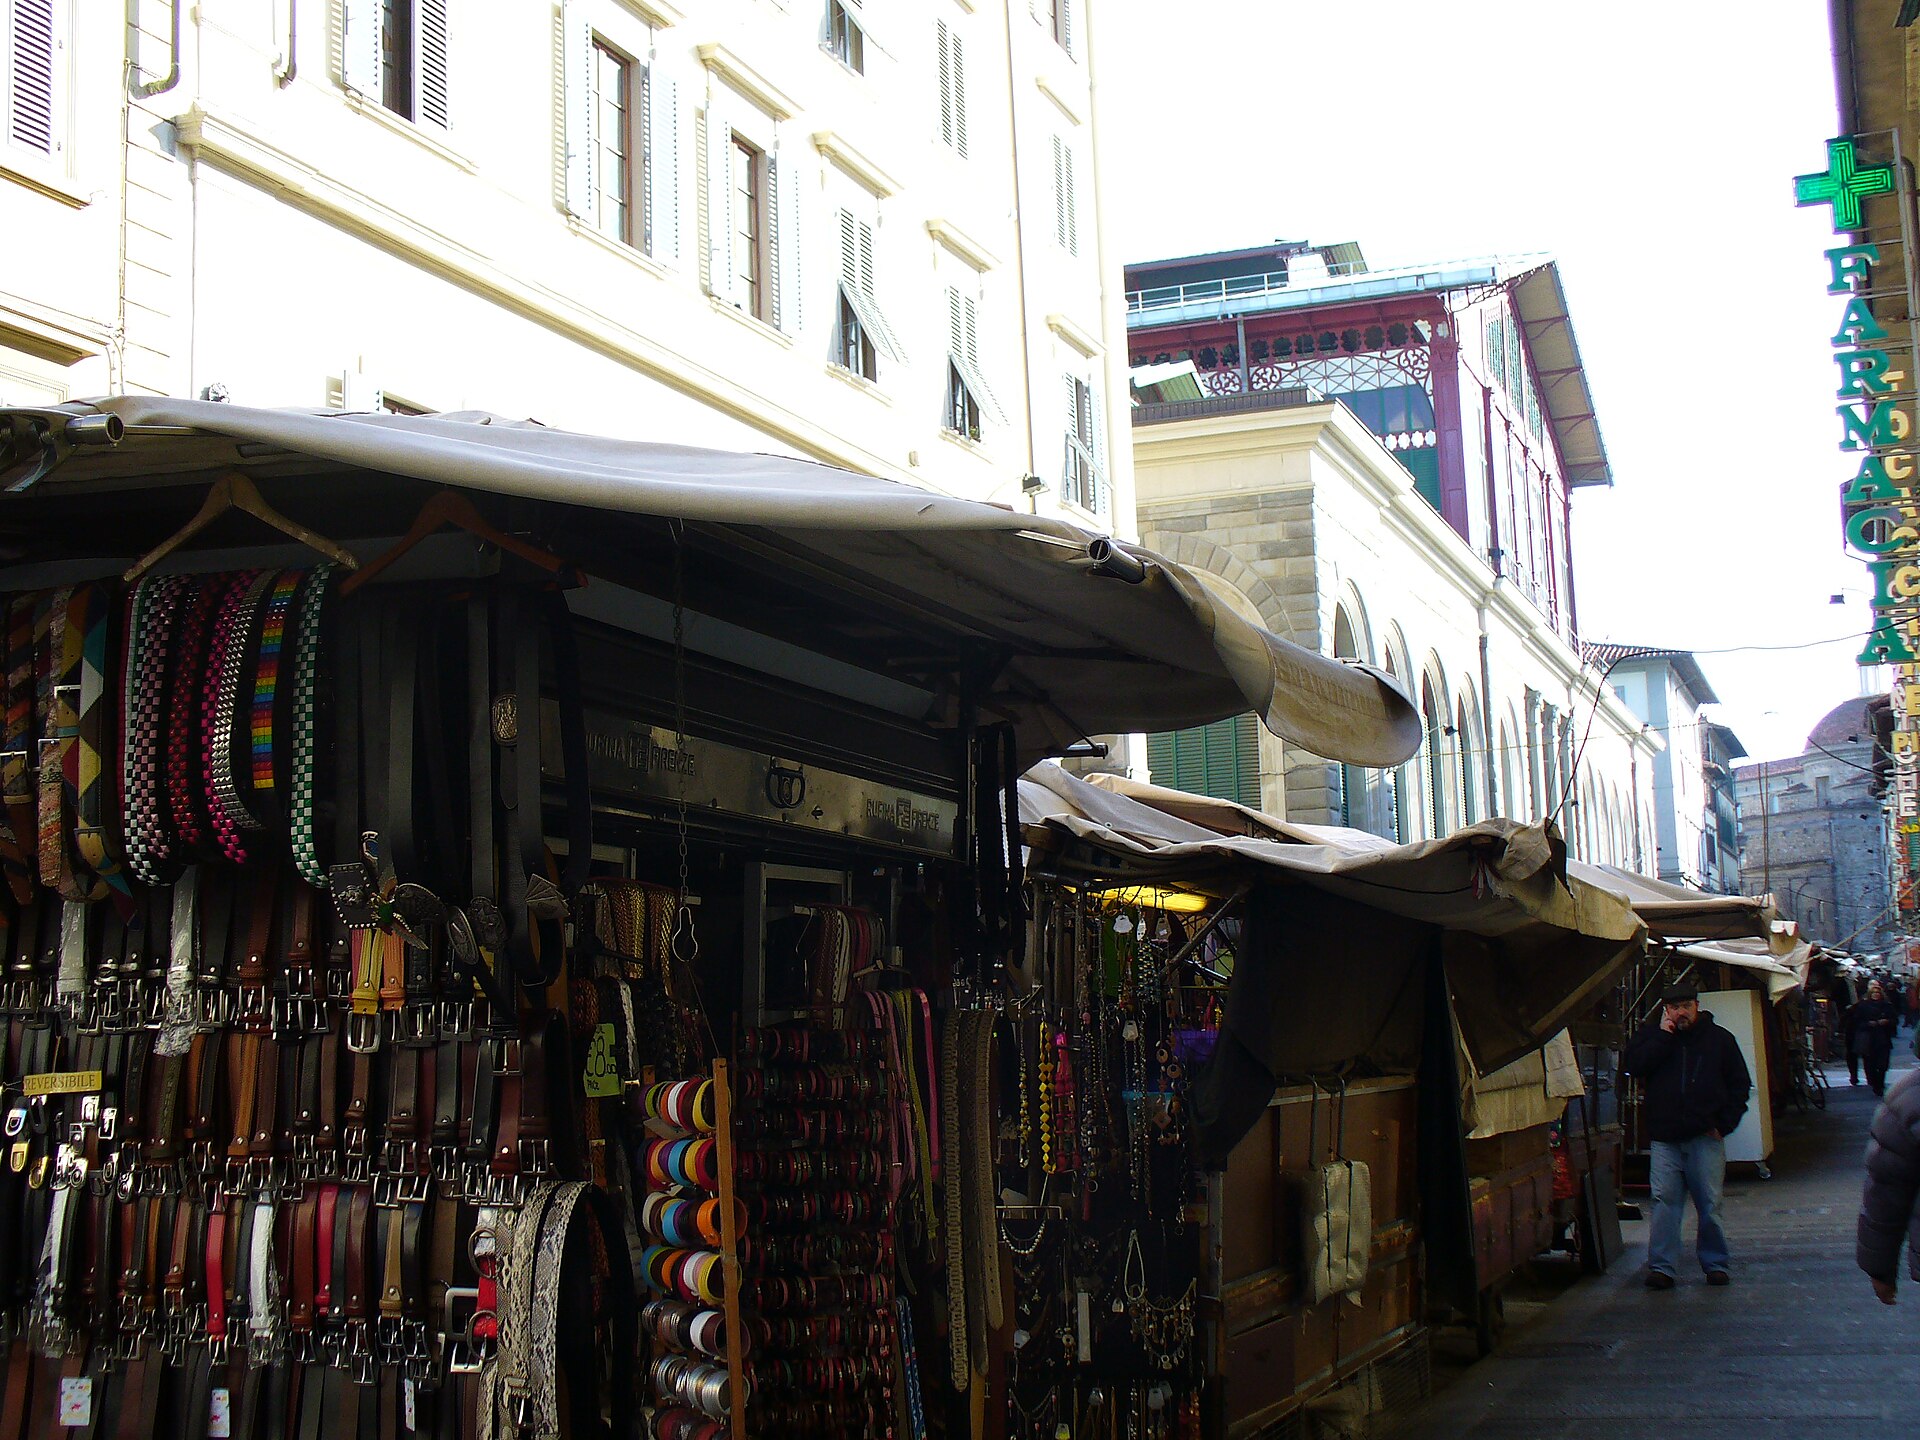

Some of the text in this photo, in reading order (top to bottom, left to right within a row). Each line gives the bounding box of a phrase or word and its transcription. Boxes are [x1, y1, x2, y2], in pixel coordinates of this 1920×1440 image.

[1824, 244, 1914, 664] FARMACIA
[867, 798, 896, 822] RUFINA
[24, 1074, 96, 1091] REVERSIBILE
